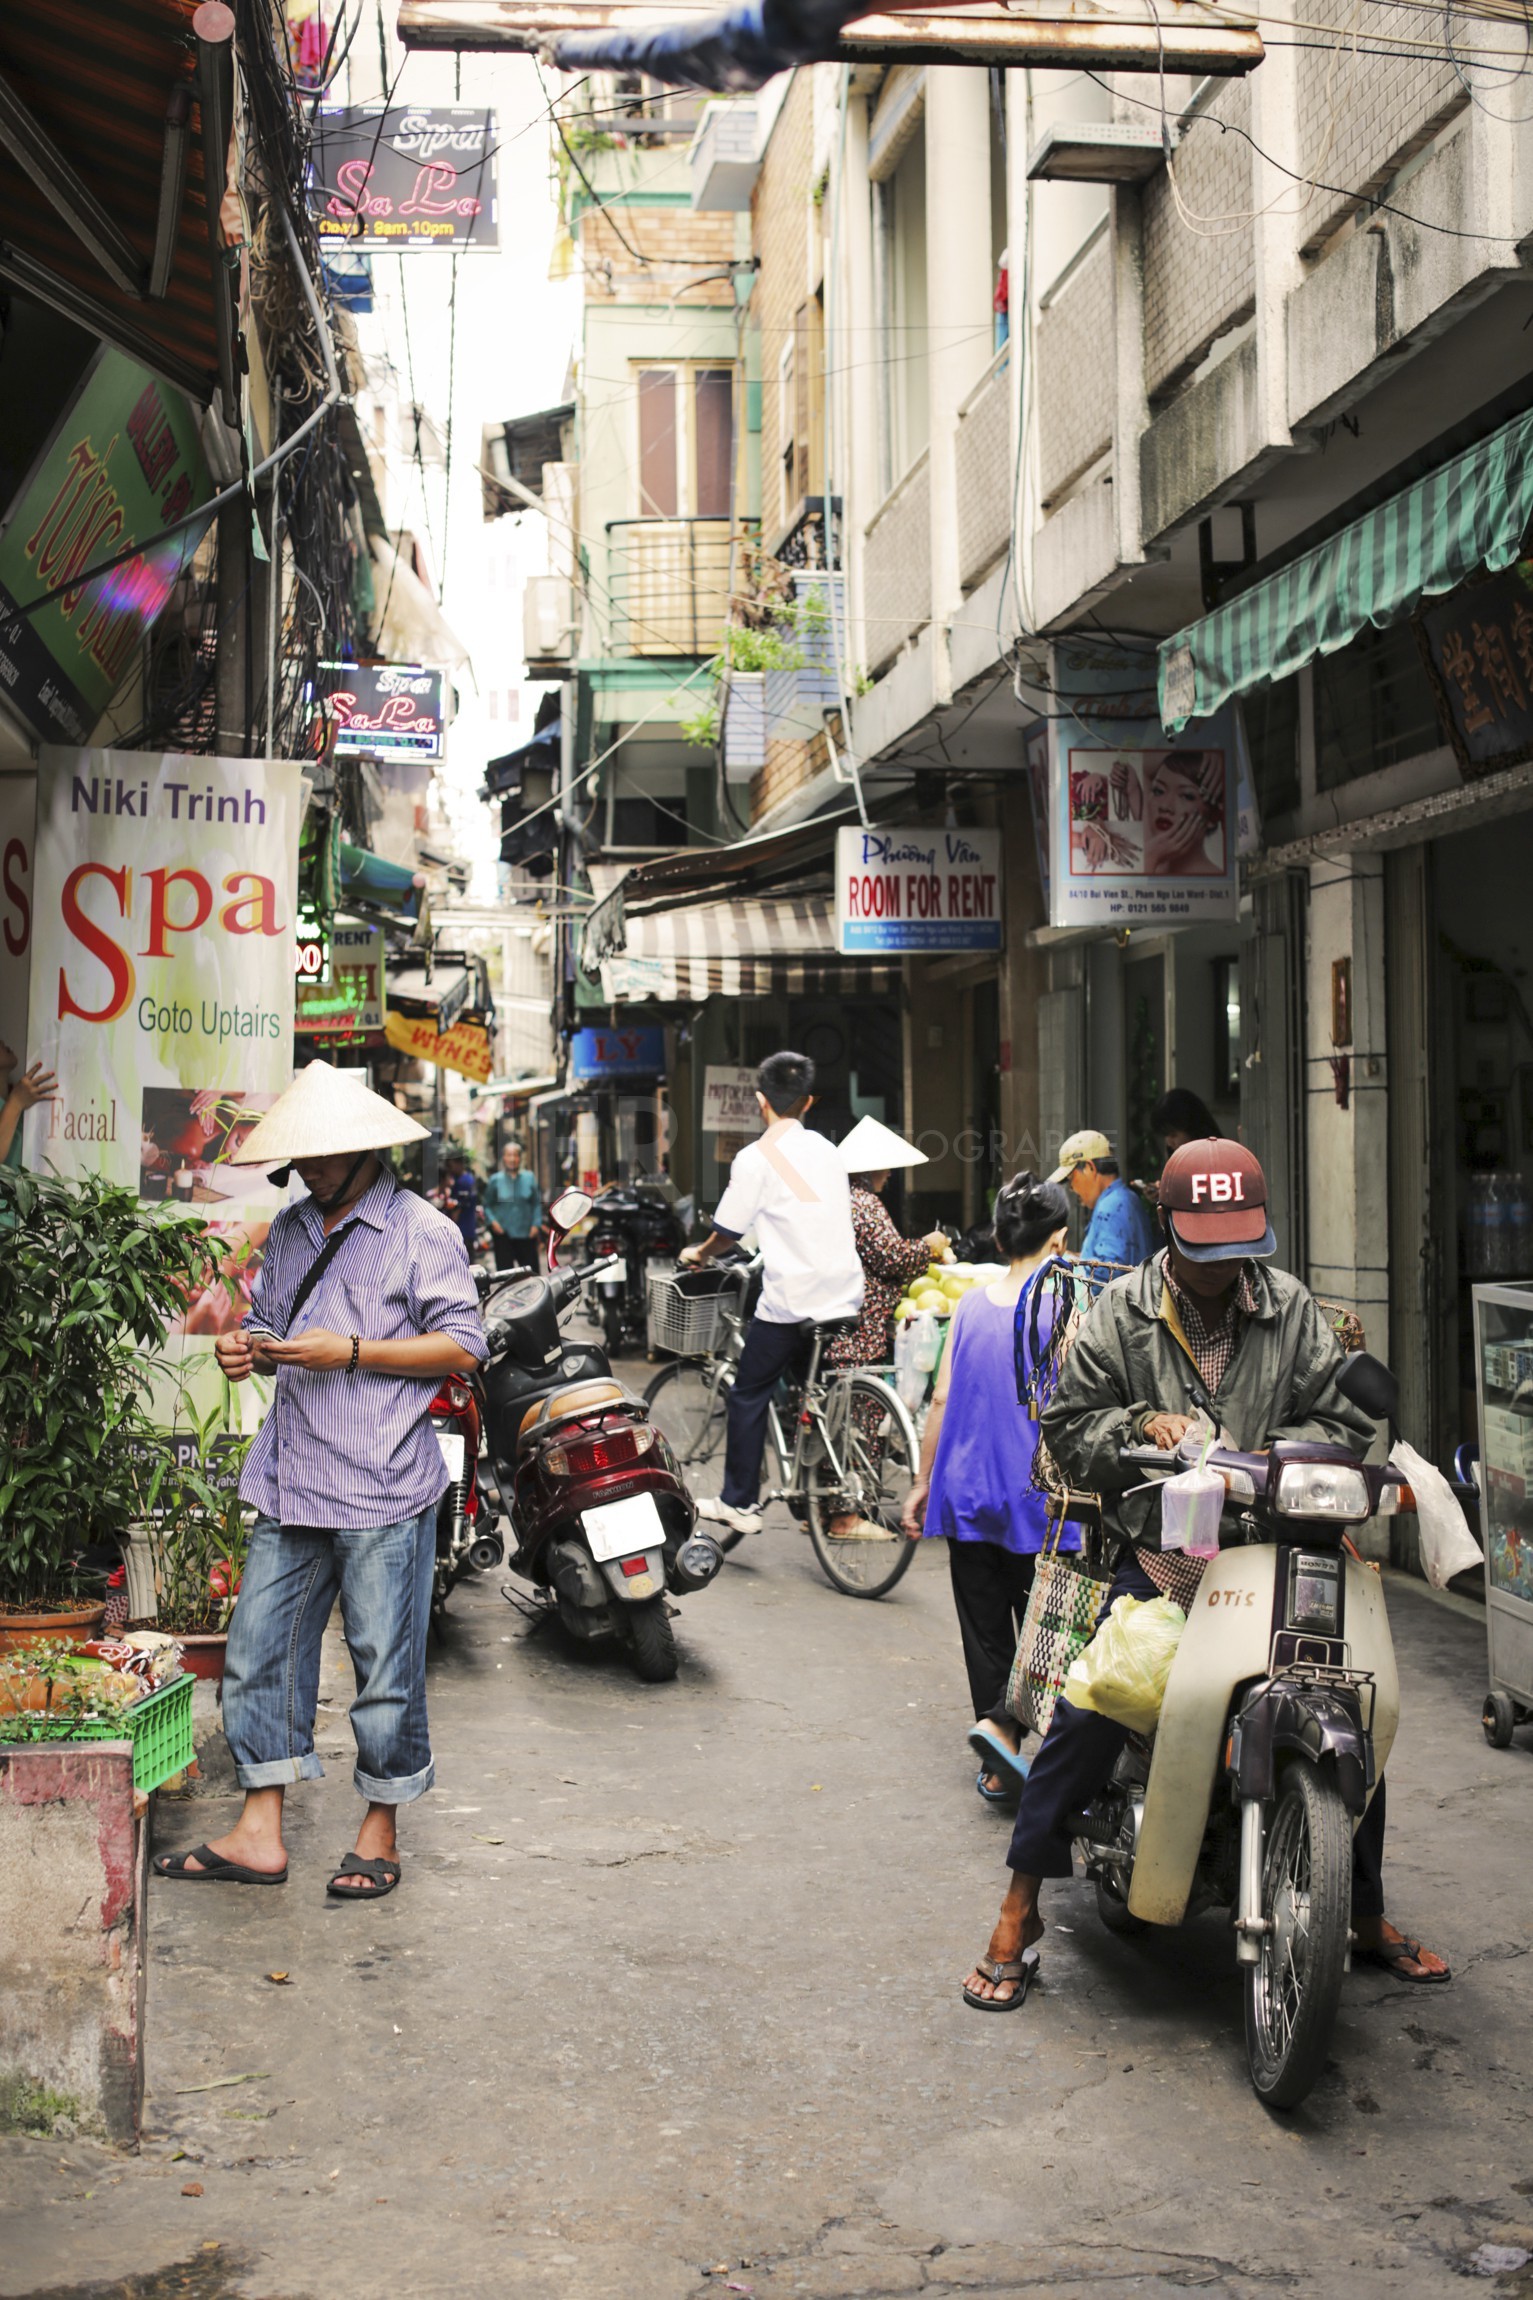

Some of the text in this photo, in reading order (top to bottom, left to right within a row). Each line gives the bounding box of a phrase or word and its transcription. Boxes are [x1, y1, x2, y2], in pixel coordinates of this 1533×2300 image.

[393, 115, 486, 158] Spa
[327, 160, 483, 217] Sa La
[375, 670, 433, 697] Spa
[71, 776, 266, 825] Niki Trinh
[849, 874, 996, 919] ROOM FOR RENT
[58, 862, 287, 1024] Spa
[334, 931, 371, 946] RENT
[138, 997, 280, 1044] Goto Uptairs
[47, 1097, 117, 1142] Facial
[1191, 1172, 1245, 1204] FBI
[1300, 1560, 1336, 1571] HONDA
